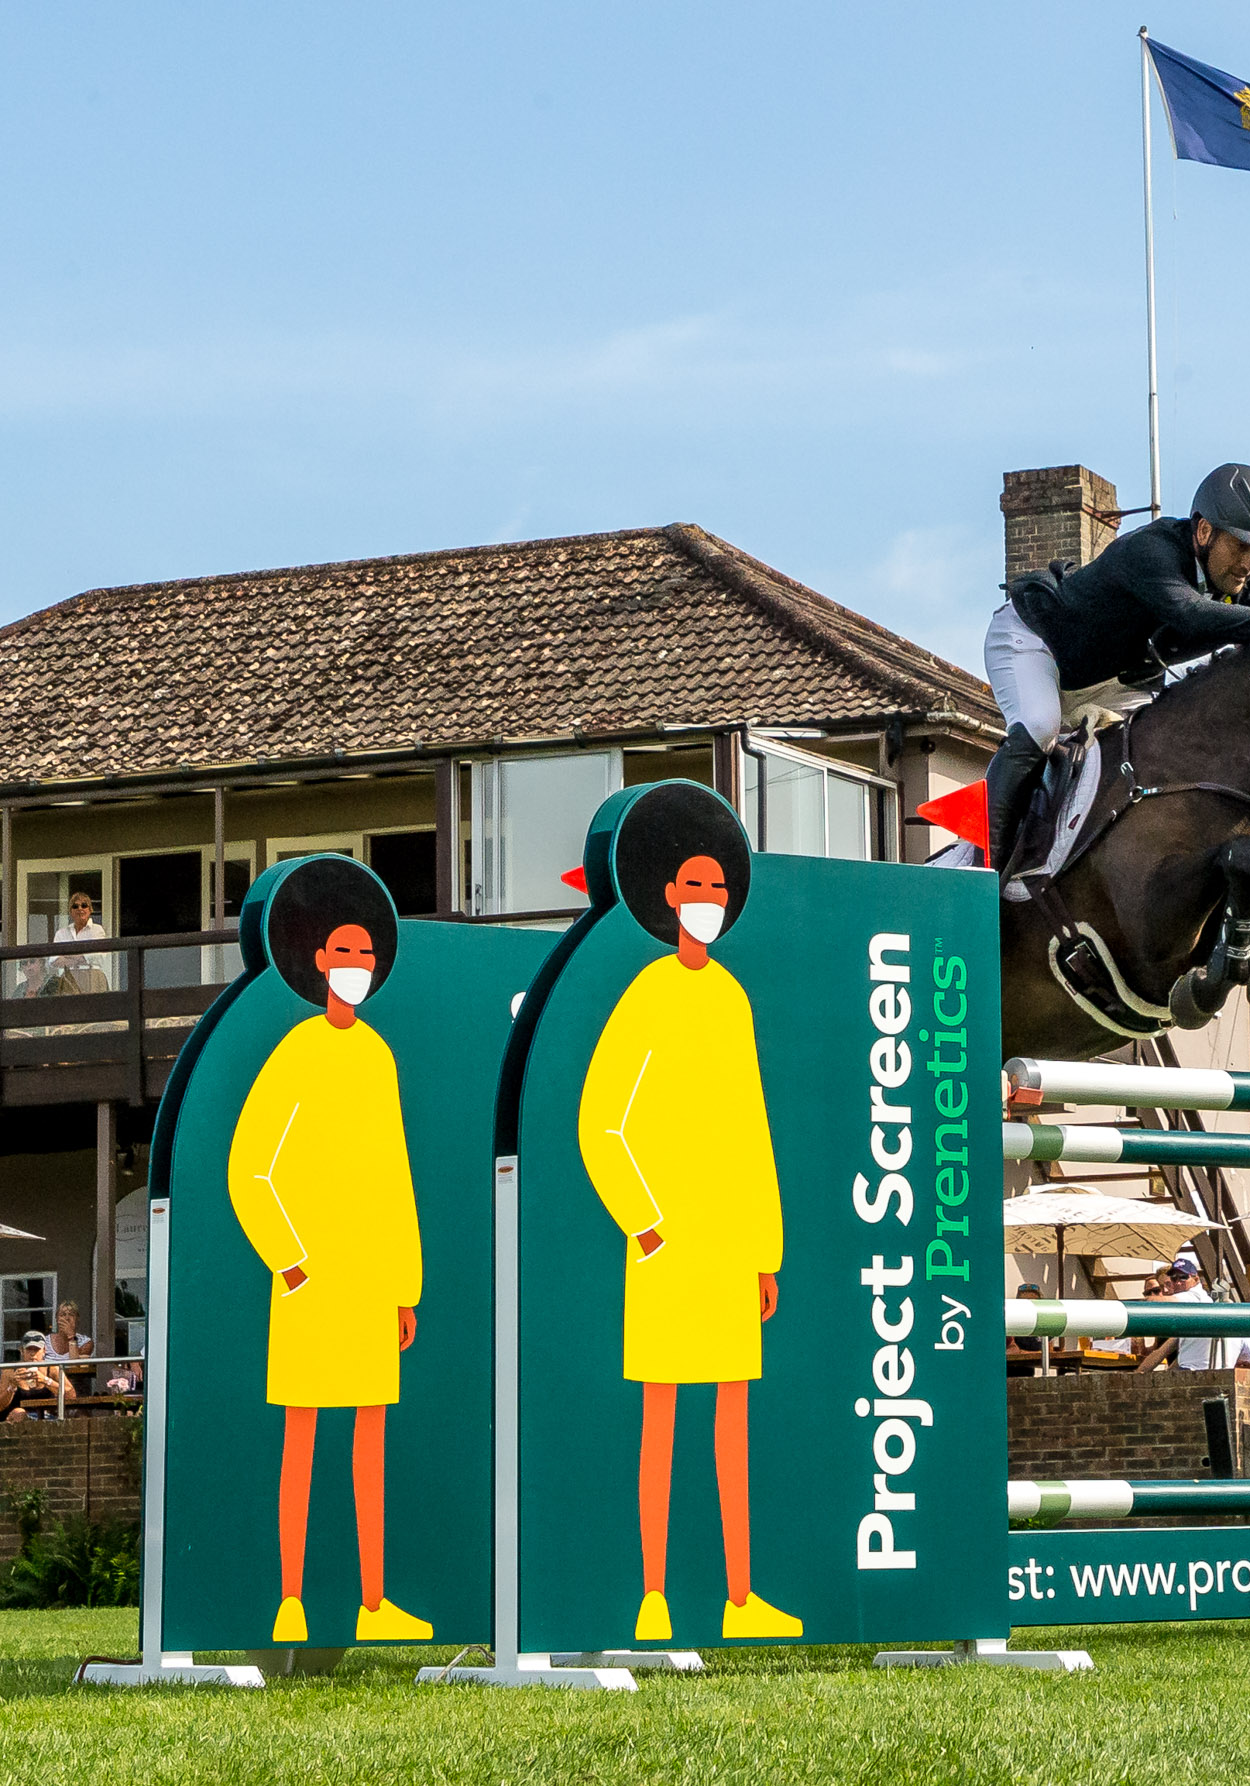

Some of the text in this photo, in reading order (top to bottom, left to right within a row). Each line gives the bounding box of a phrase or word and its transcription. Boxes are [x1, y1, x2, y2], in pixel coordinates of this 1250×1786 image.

[852, 932, 934, 1570] Project Screen
[934, 1294, 972, 1350] by
